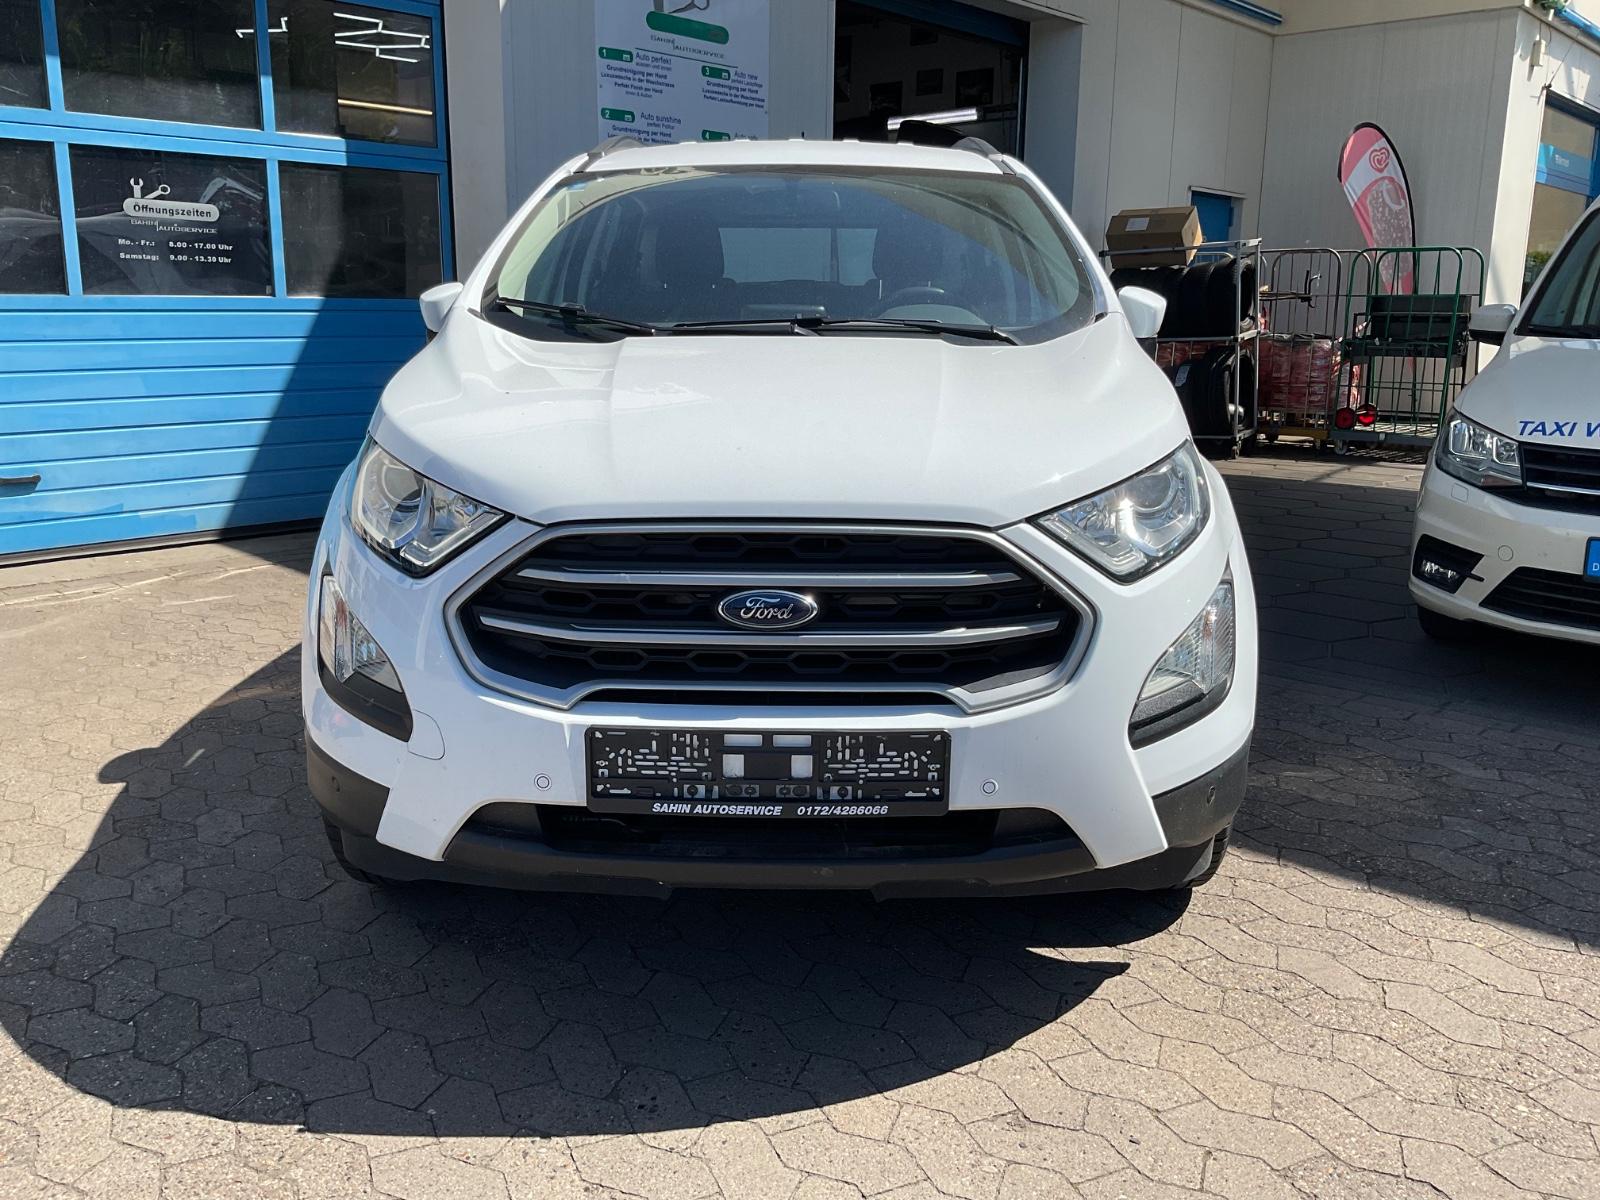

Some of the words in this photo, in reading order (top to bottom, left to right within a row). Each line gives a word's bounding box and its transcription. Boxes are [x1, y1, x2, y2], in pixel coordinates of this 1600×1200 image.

[602, 49, 607, 57] 1
[636, 52, 650, 61] Auto
[651, 56, 672, 65] perfekt
[606, 64, 645, 77] Grundreinigung
[655, 72, 667, 80] Hand
[706, 67, 709, 75] 3
[735, 70, 746, 79] Auto
[604, 110, 610, 119] 2
[640, 112, 654, 121] Auto
[656, 114, 681, 124] sunshine
[612, 124, 650, 136] Grundreinigung
[133, 202, 211, 217] Öffnungszeiten
[158, 225, 218, 234] AUTOSERVICE
[120, 252, 159, 261] Samstag:
[1519, 421, 1578, 436] TAXI
[740, 597, 793, 619] Ford
[652, 802, 691, 814] SAHIN
[693, 804, 782, 816] AUTOSERVICE
[797, 805, 888, 816] 0172/4286066
